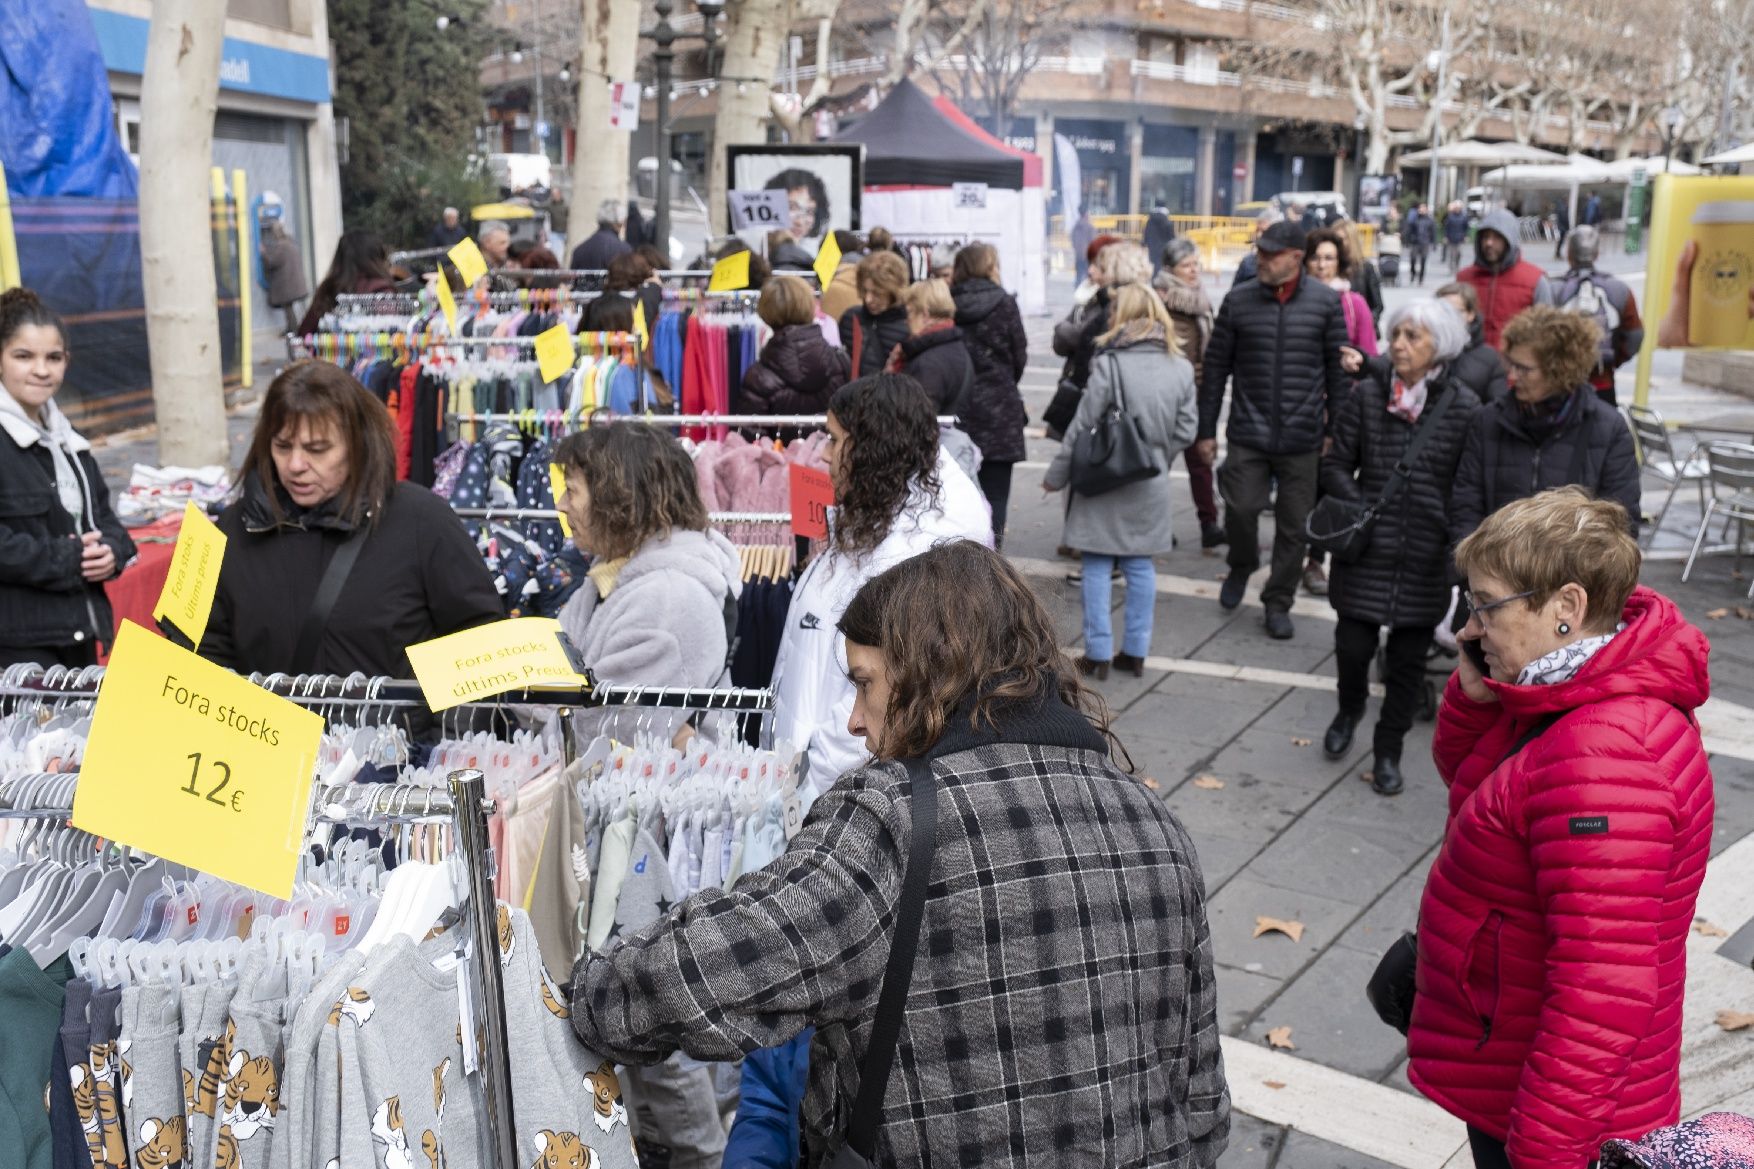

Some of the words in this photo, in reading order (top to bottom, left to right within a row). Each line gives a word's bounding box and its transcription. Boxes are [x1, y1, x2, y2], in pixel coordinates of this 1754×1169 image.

[171, 569, 186, 600] Fora
[185, 578, 202, 620] Últims
[198, 542, 212, 578] preus
[455, 653, 492, 671] Fora
[496, 641, 548, 659] stocks
[453, 670, 518, 697] últims
[522, 664, 571, 678] Preus
[162, 675, 210, 716] Fora
[215, 706, 280, 746] stocks
[181, 752, 245, 813] 12€
